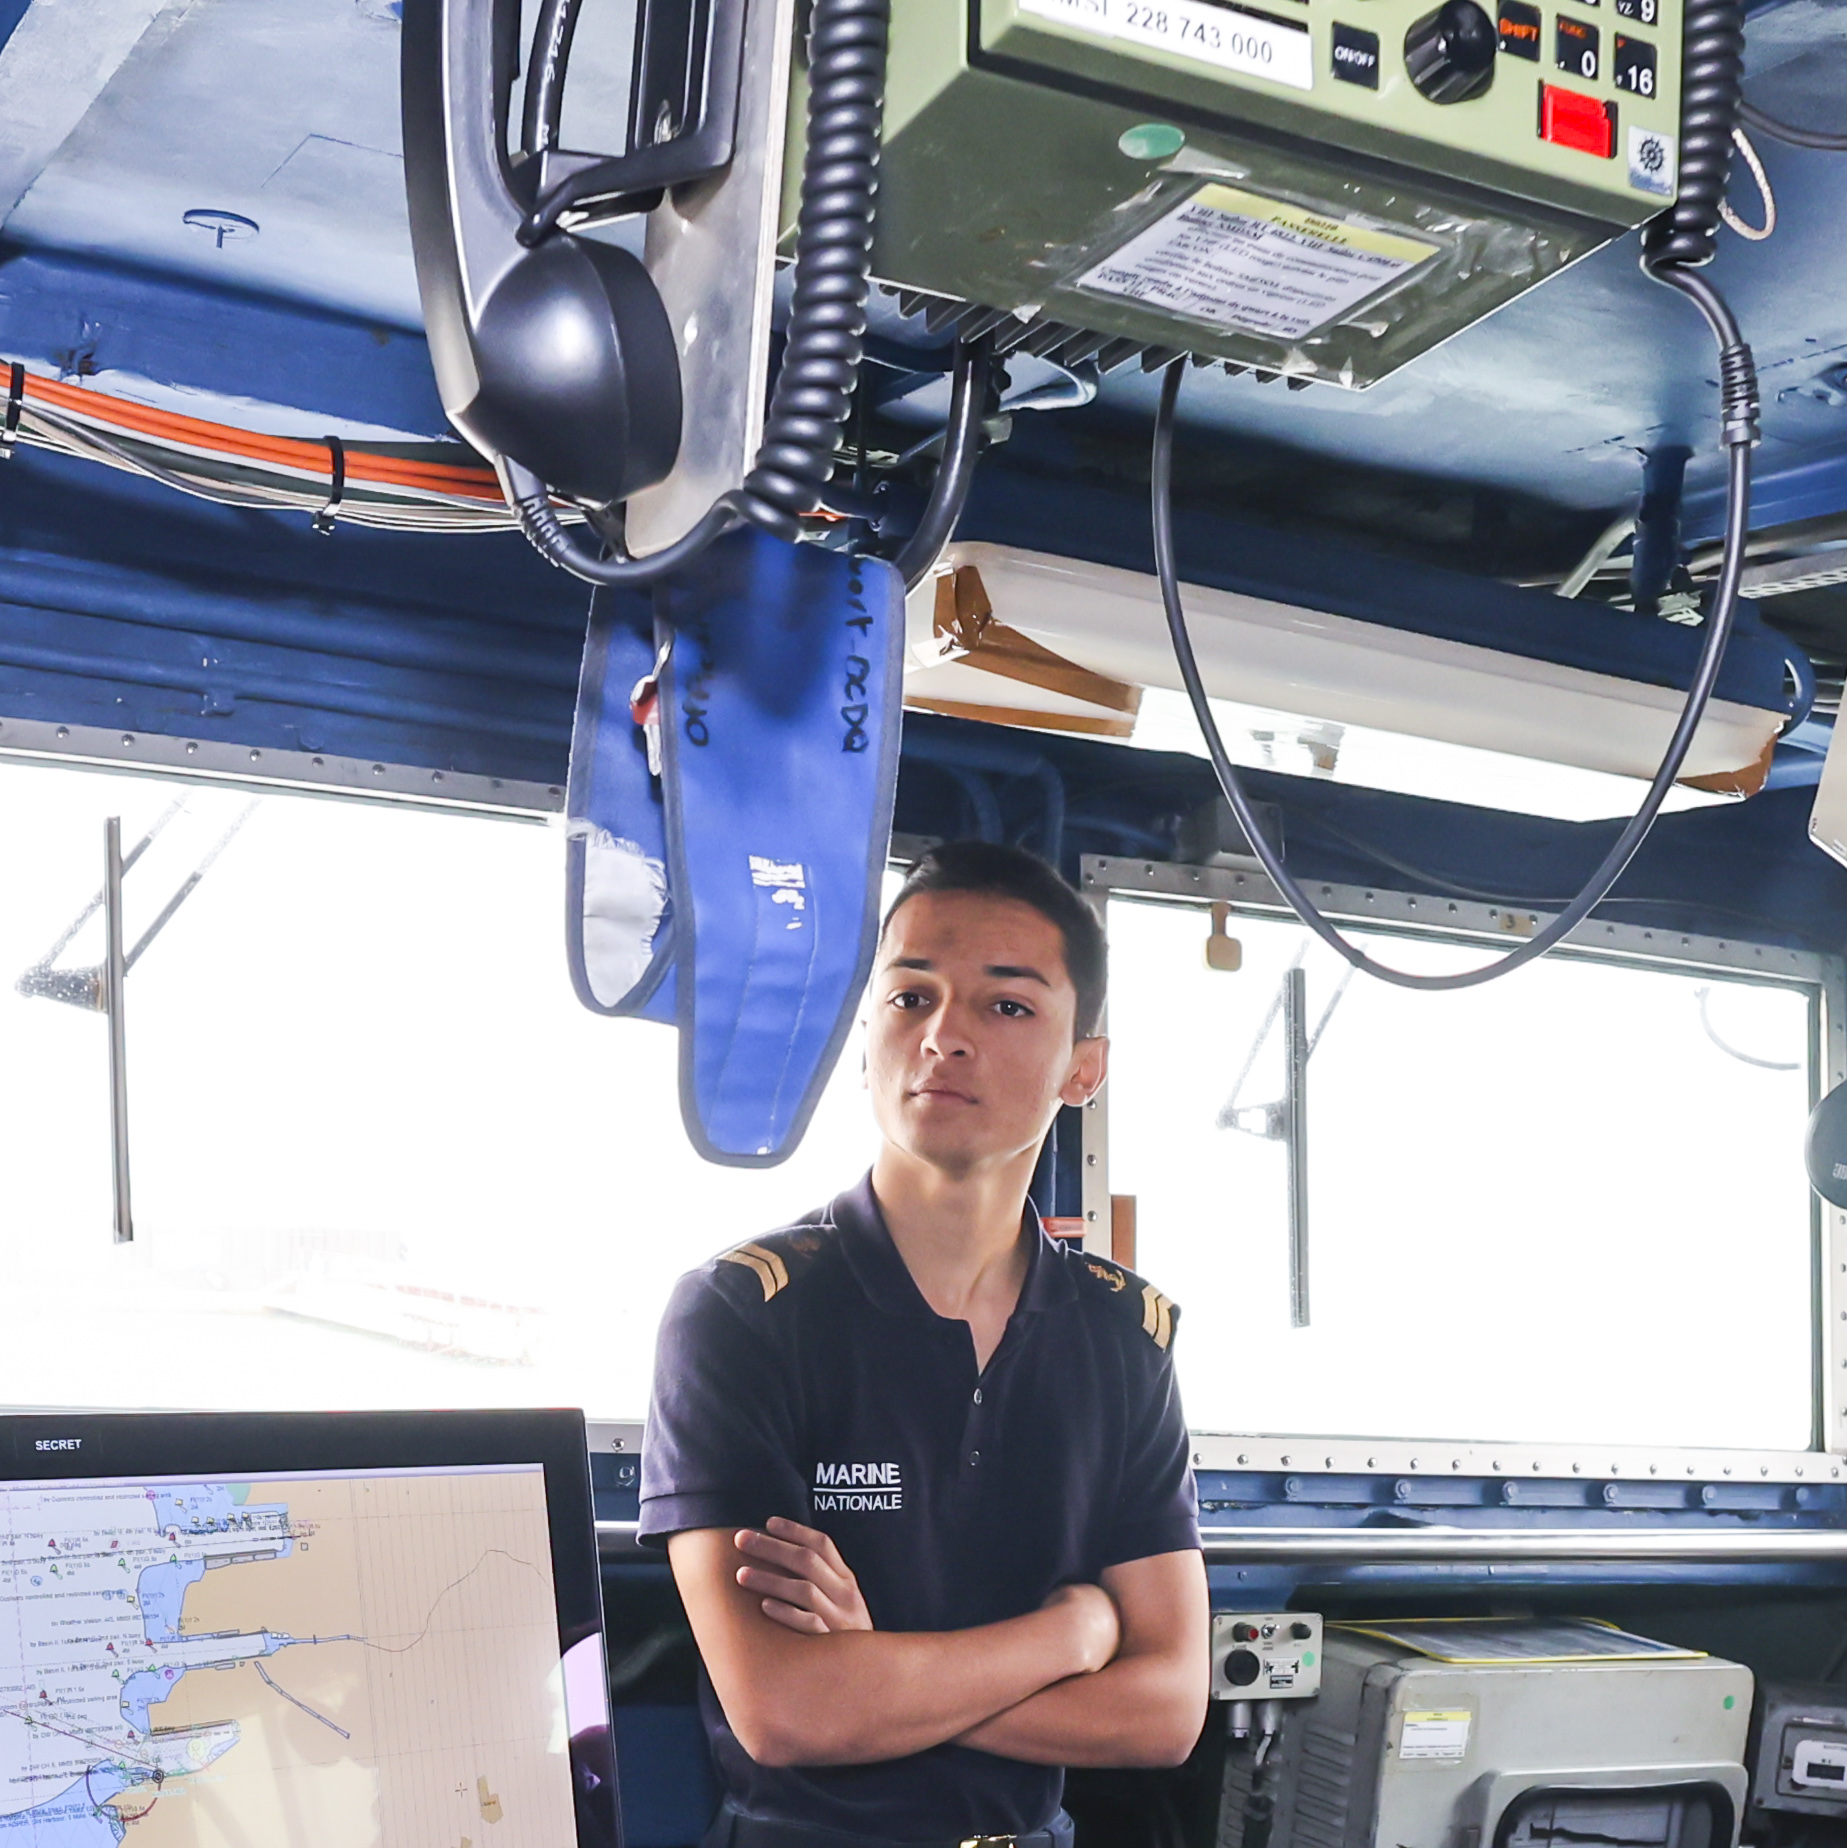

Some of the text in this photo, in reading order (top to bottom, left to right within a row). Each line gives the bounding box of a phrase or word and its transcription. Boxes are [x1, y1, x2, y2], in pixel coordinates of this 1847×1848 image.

[1641, 0, 1654, 22] 9
[1127, 3, 1273, 63] 228 743 000
[1334, 45, 1375, 68] ON/OFF
[1581, 51, 1596, 77] 0
[1628, 65, 1653, 94] 16
[35, 1439, 82, 1452] SECRET
[816, 1462, 901, 1485] MARINE
[814, 1494, 902, 1511] NATIONALE
